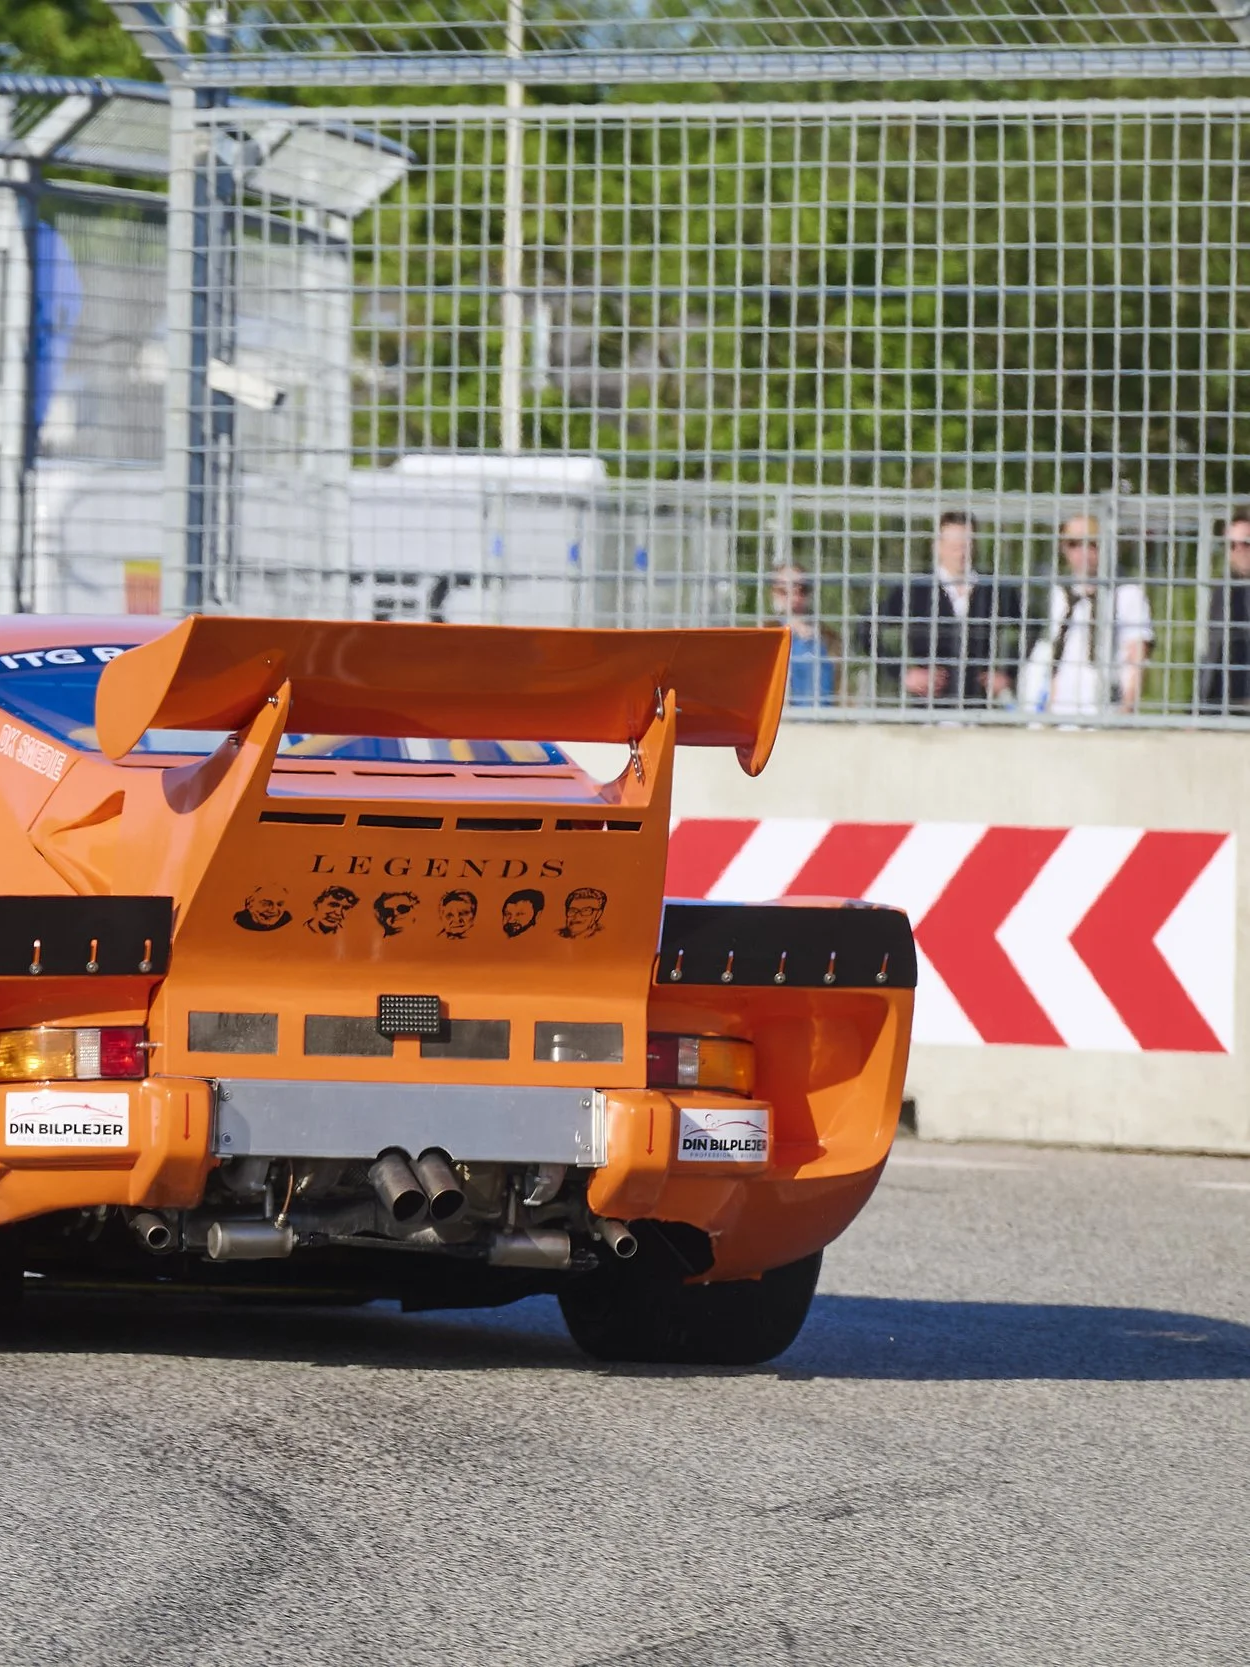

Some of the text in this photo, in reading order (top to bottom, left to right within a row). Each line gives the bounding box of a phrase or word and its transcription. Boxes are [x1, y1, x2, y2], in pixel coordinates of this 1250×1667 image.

[0, 649, 86, 669] ITG
[308, 854, 565, 878] LEGENDS
[10, 1123, 123, 1136] DIN BILPLEJER
[682, 1138, 708, 1151] DIN
